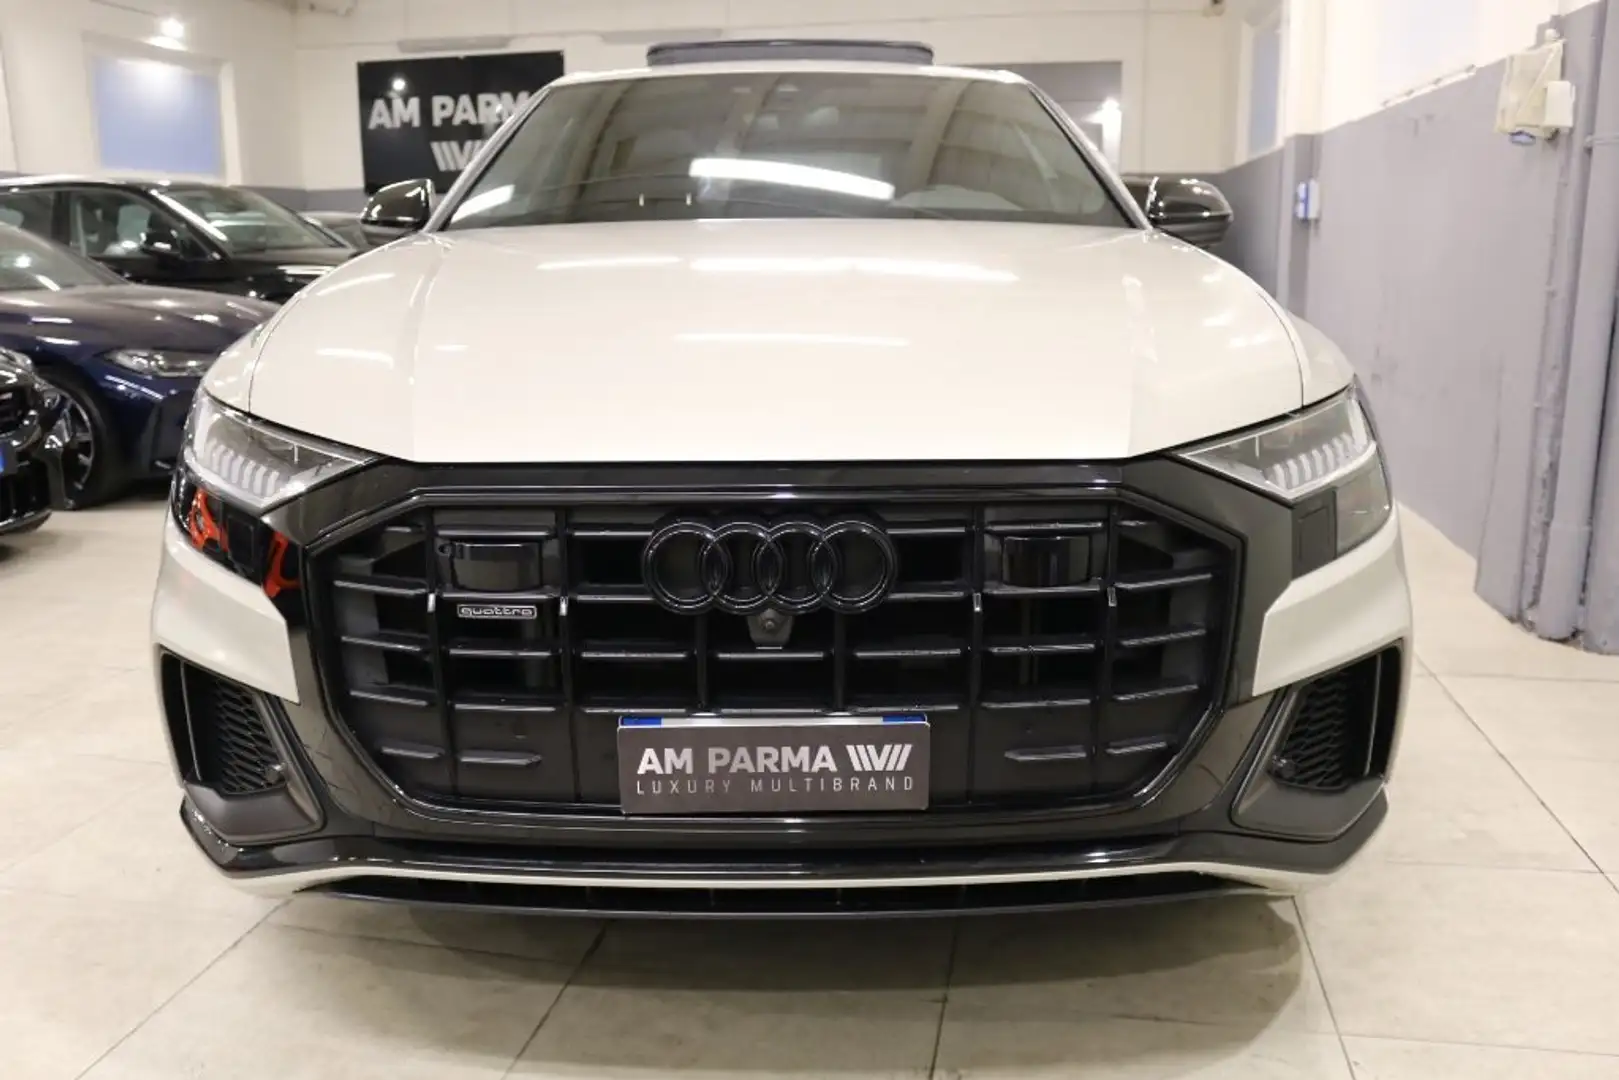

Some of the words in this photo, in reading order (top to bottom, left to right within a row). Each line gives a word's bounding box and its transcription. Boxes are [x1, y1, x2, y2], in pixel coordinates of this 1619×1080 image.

[368, 96, 421, 129] AM
[432, 91, 530, 127] PARM
[461, 606, 533, 617] quattro
[636, 747, 694, 775] AM
[707, 745, 837, 774] PARMA
[636, 778, 732, 796] LUXURY
[750, 776, 913, 794] MULTIBRAND
